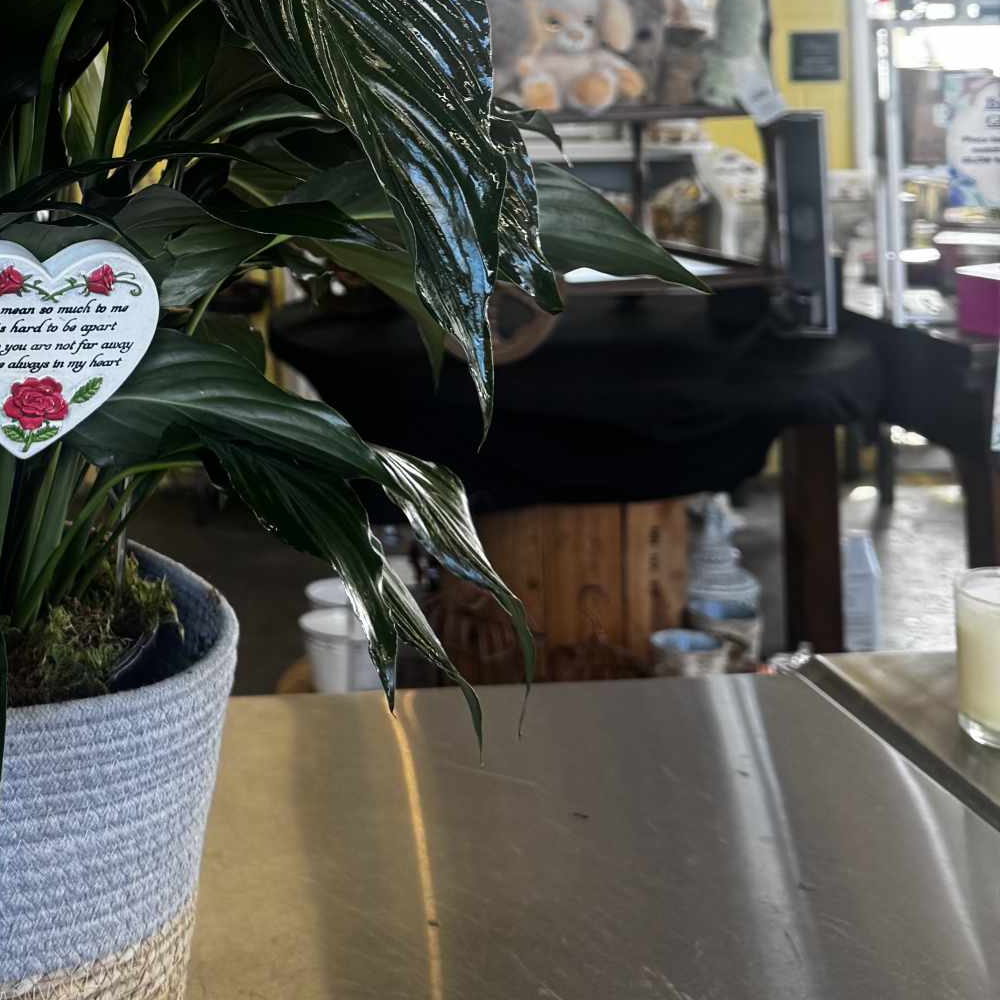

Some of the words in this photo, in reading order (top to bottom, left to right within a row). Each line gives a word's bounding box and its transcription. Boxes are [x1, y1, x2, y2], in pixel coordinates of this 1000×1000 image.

[1, 306, 35, 315] mean
[39, 306, 53, 315] so
[57, 299, 96, 314] much
[95, 303, 107, 313] to
[110, 305, 129, 313] me
[10, 318, 52, 333] hard
[47, 322, 58, 332] to
[62, 318, 78, 332] be
[80, 321, 118, 336] apart
[30, 343, 51, 351] are
[55, 340, 76, 351] not
[70, 339, 98, 355] far
[101, 341, 134, 353] away
[7, 355, 50, 373] always
[52, 358, 65, 368] in
[67, 360, 87, 373] my
[89, 353, 122, 367] heart
